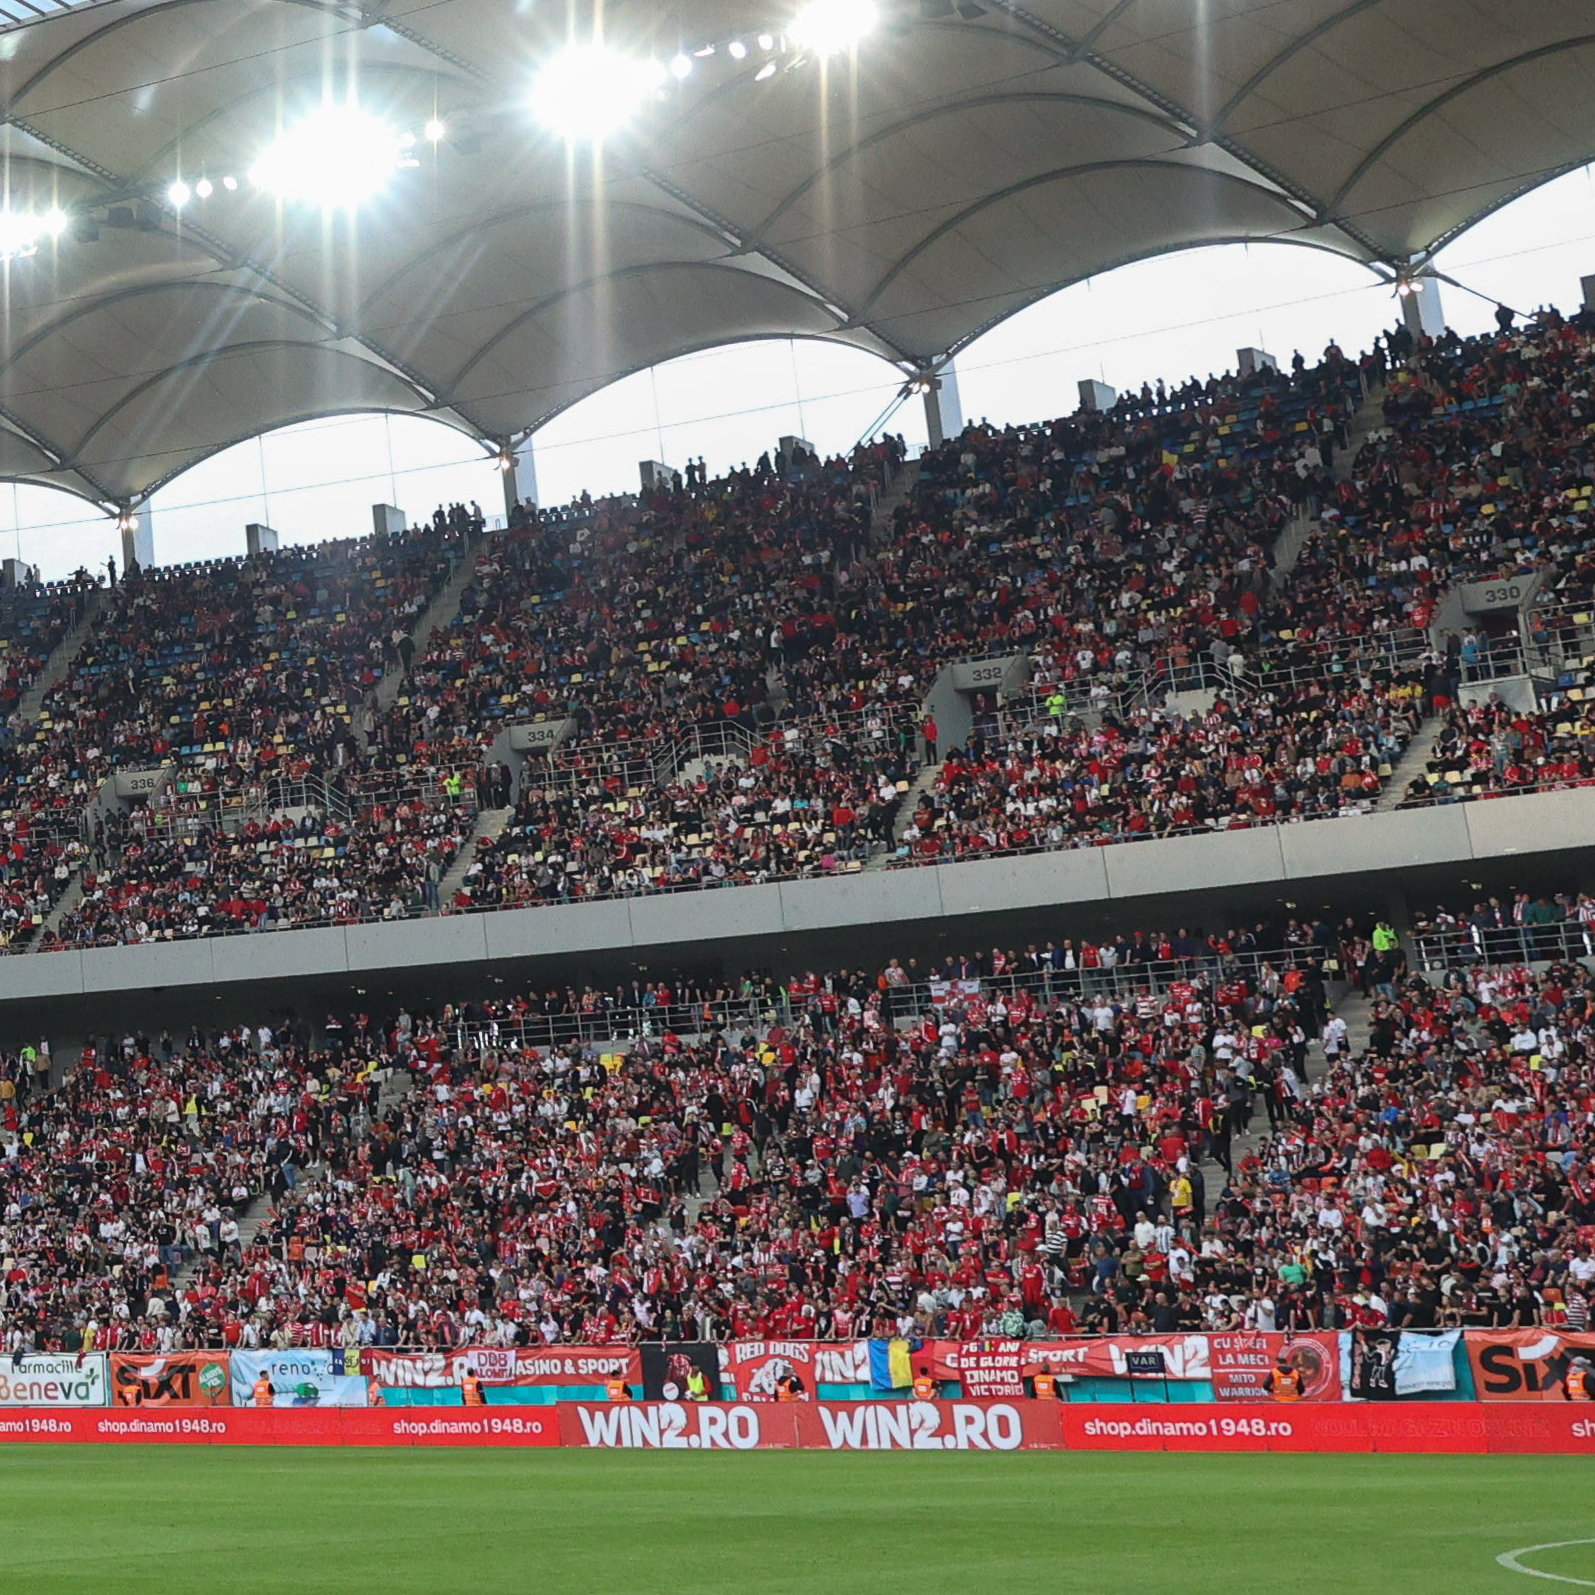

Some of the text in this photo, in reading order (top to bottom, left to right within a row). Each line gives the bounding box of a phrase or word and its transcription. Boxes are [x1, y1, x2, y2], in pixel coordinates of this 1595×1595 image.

[1485, 586, 1521, 603] 330
[973, 667, 1002, 682] 332
[527, 729, 555, 743] 334
[131, 777, 155, 790] 336
[1213, 1337, 1231, 1350] CU
[735, 1341, 810, 1364] RED DOGS
[1028, 1347, 1089, 1363] SPORT
[1217, 1354, 1270, 1366] LA MECI
[515, 1357, 630, 1375] ASINO & SPORT
[960, 1357, 977, 1368] DE
[979, 1356, 1018, 1368] GLORIE
[1132, 1355, 1157, 1367] VAR
[964, 1369, 1019, 1384] DINAMO
[1227, 1373, 1257, 1384] MITO
[97, 1418, 226, 1435] shop.dinamo1948.ro
[393, 1418, 543, 1436] shop.dinamo1948.ro
[577, 1403, 760, 1448] WIN2.RO
[817, 1401, 1024, 1450] WIN2.RO
[1084, 1417, 1293, 1438] shop.dinamo1948.ro
